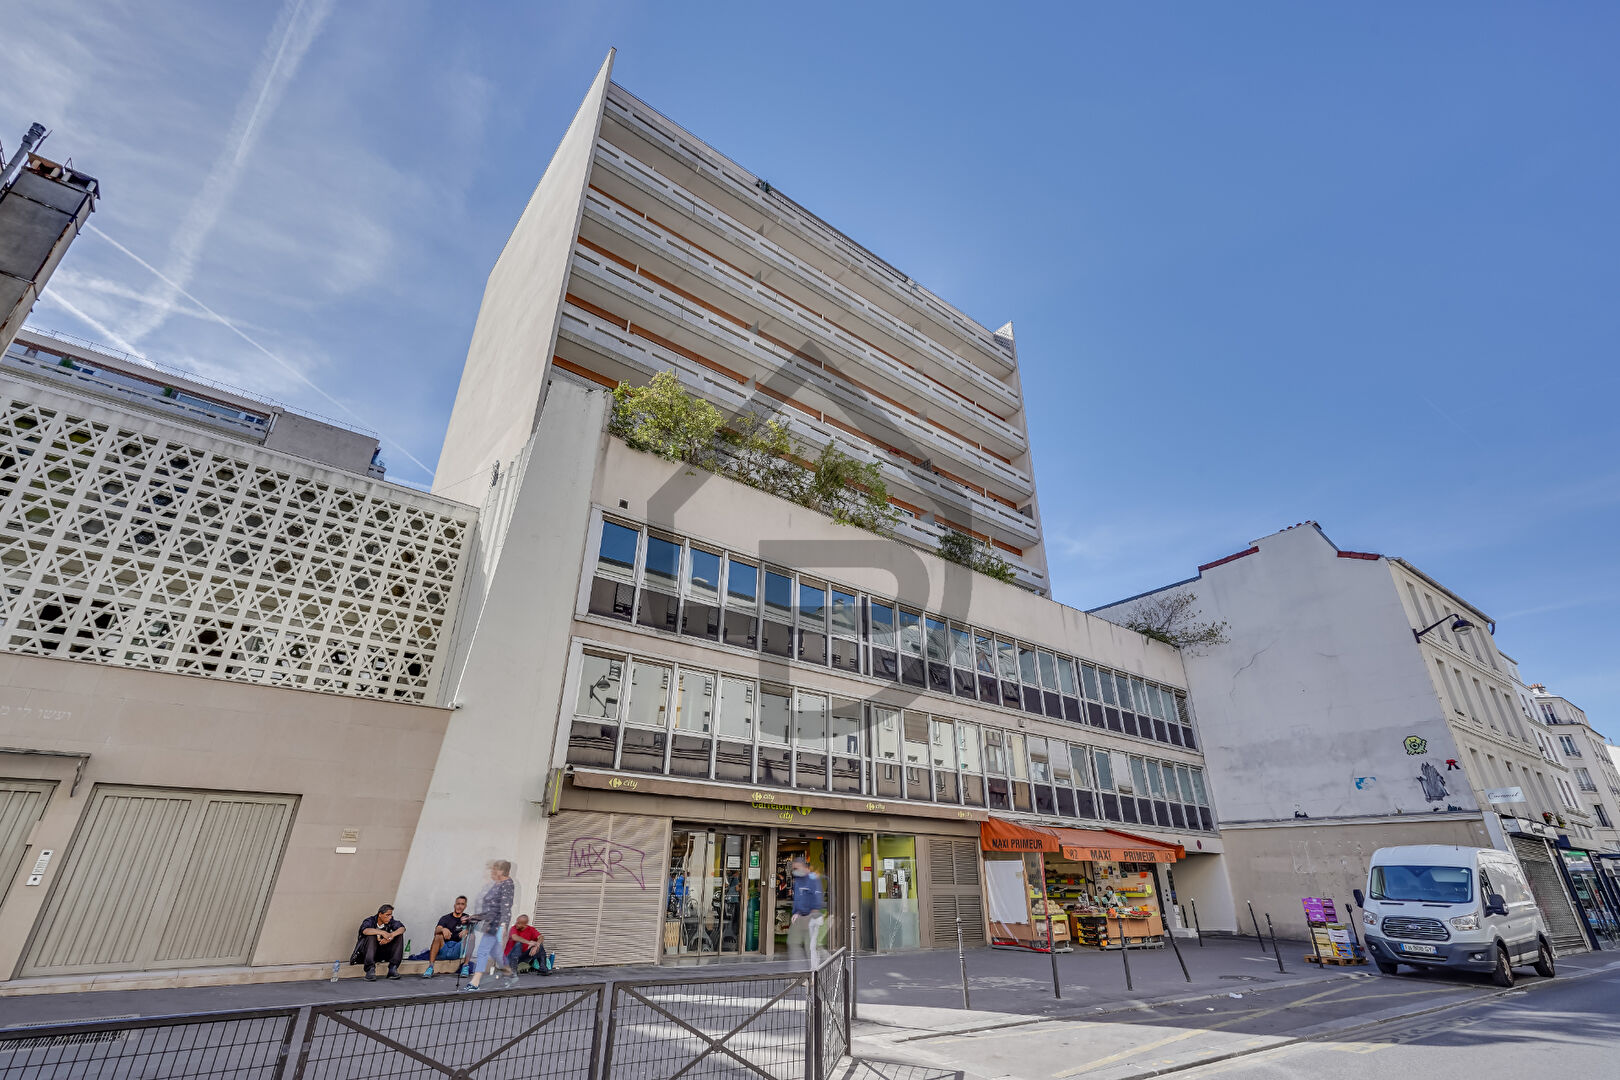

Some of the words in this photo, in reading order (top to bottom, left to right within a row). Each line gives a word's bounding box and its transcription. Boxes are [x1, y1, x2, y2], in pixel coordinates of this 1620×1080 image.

[623, 779, 638, 790] city
[778, 811, 794, 822] city
[1011, 839, 1043, 850] PRIMEUR
[1090, 850, 1112, 861] MAXI
[1123, 850, 1156, 862] PRIMEUR
